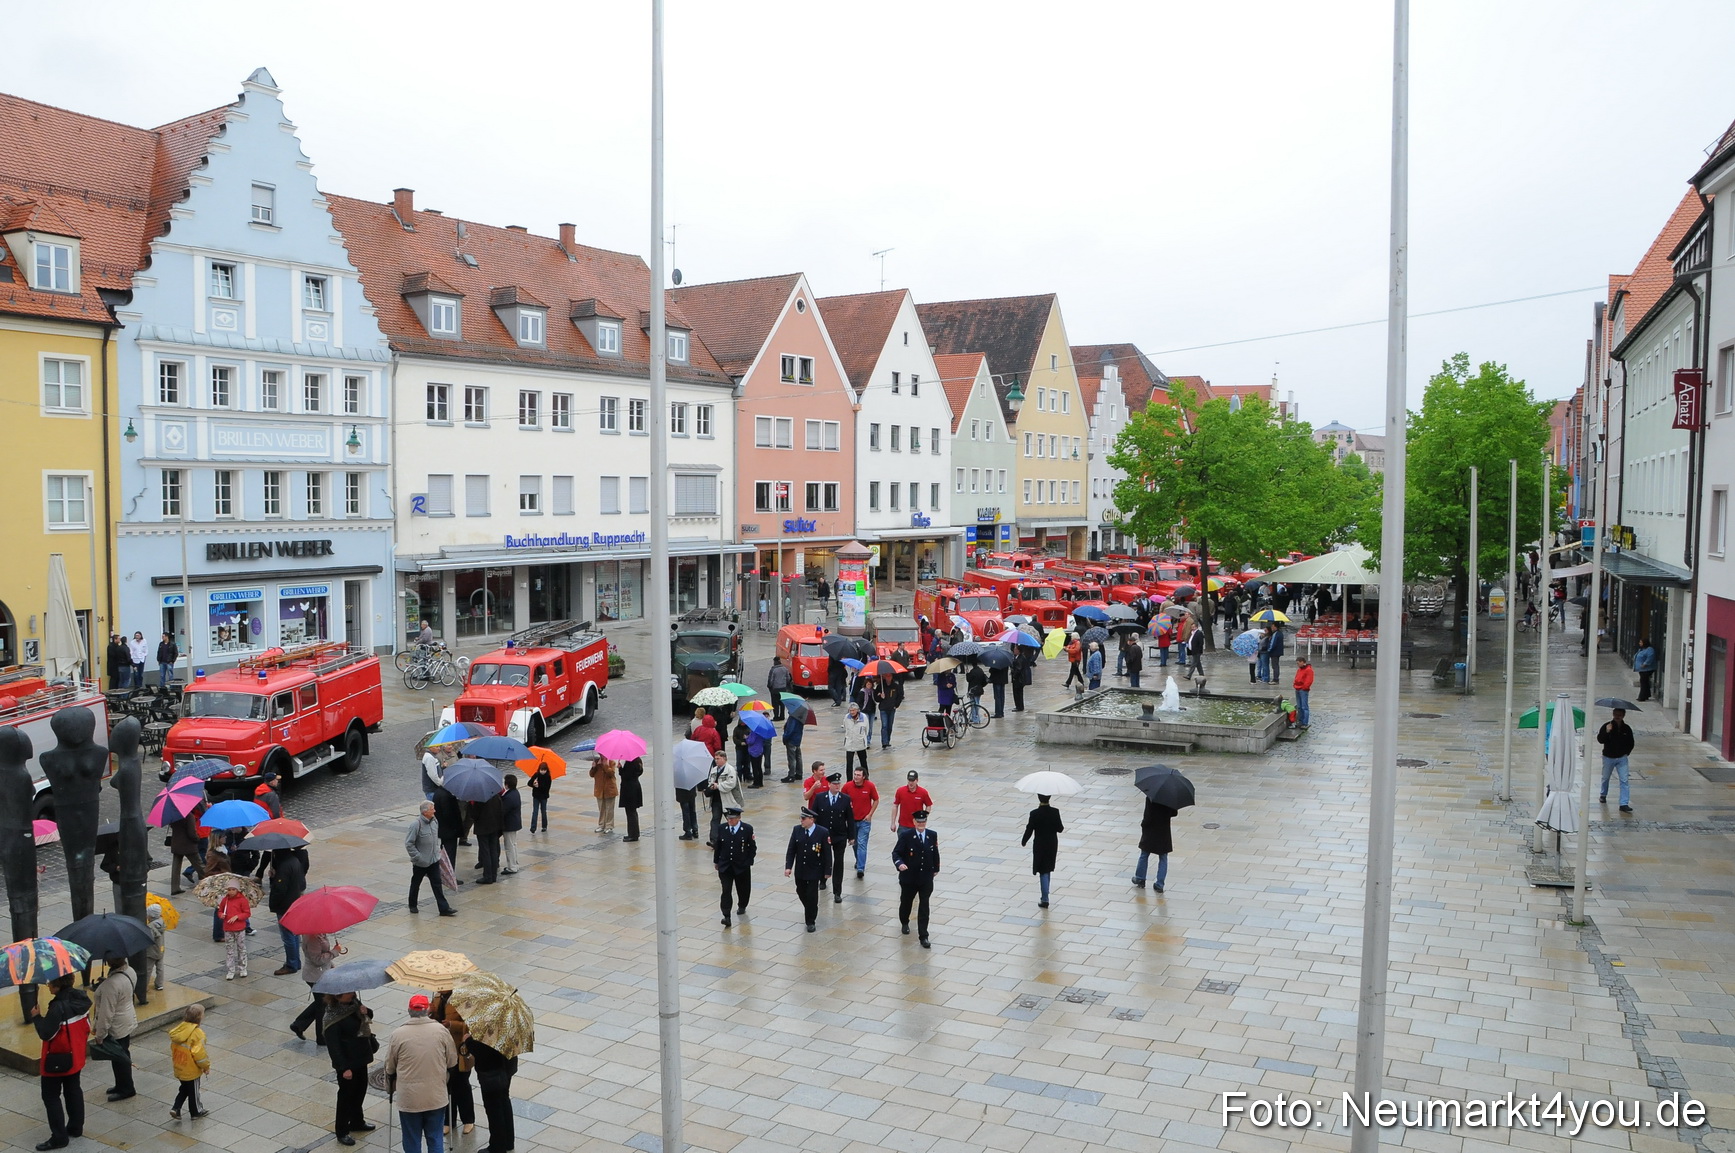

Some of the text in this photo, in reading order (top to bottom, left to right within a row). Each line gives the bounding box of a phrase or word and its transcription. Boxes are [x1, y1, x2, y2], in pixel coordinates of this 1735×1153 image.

[1679, 381, 1696, 426] Achatz
[218, 431, 324, 449] BRILLEN WEBER
[505, 530, 646, 549] Buchhandlung Rupprecht
[206, 540, 335, 560] BRILLEN WEBER
[282, 586, 327, 596] BRILLEN WEBER
[575, 650, 604, 673] FEUERWEHR
